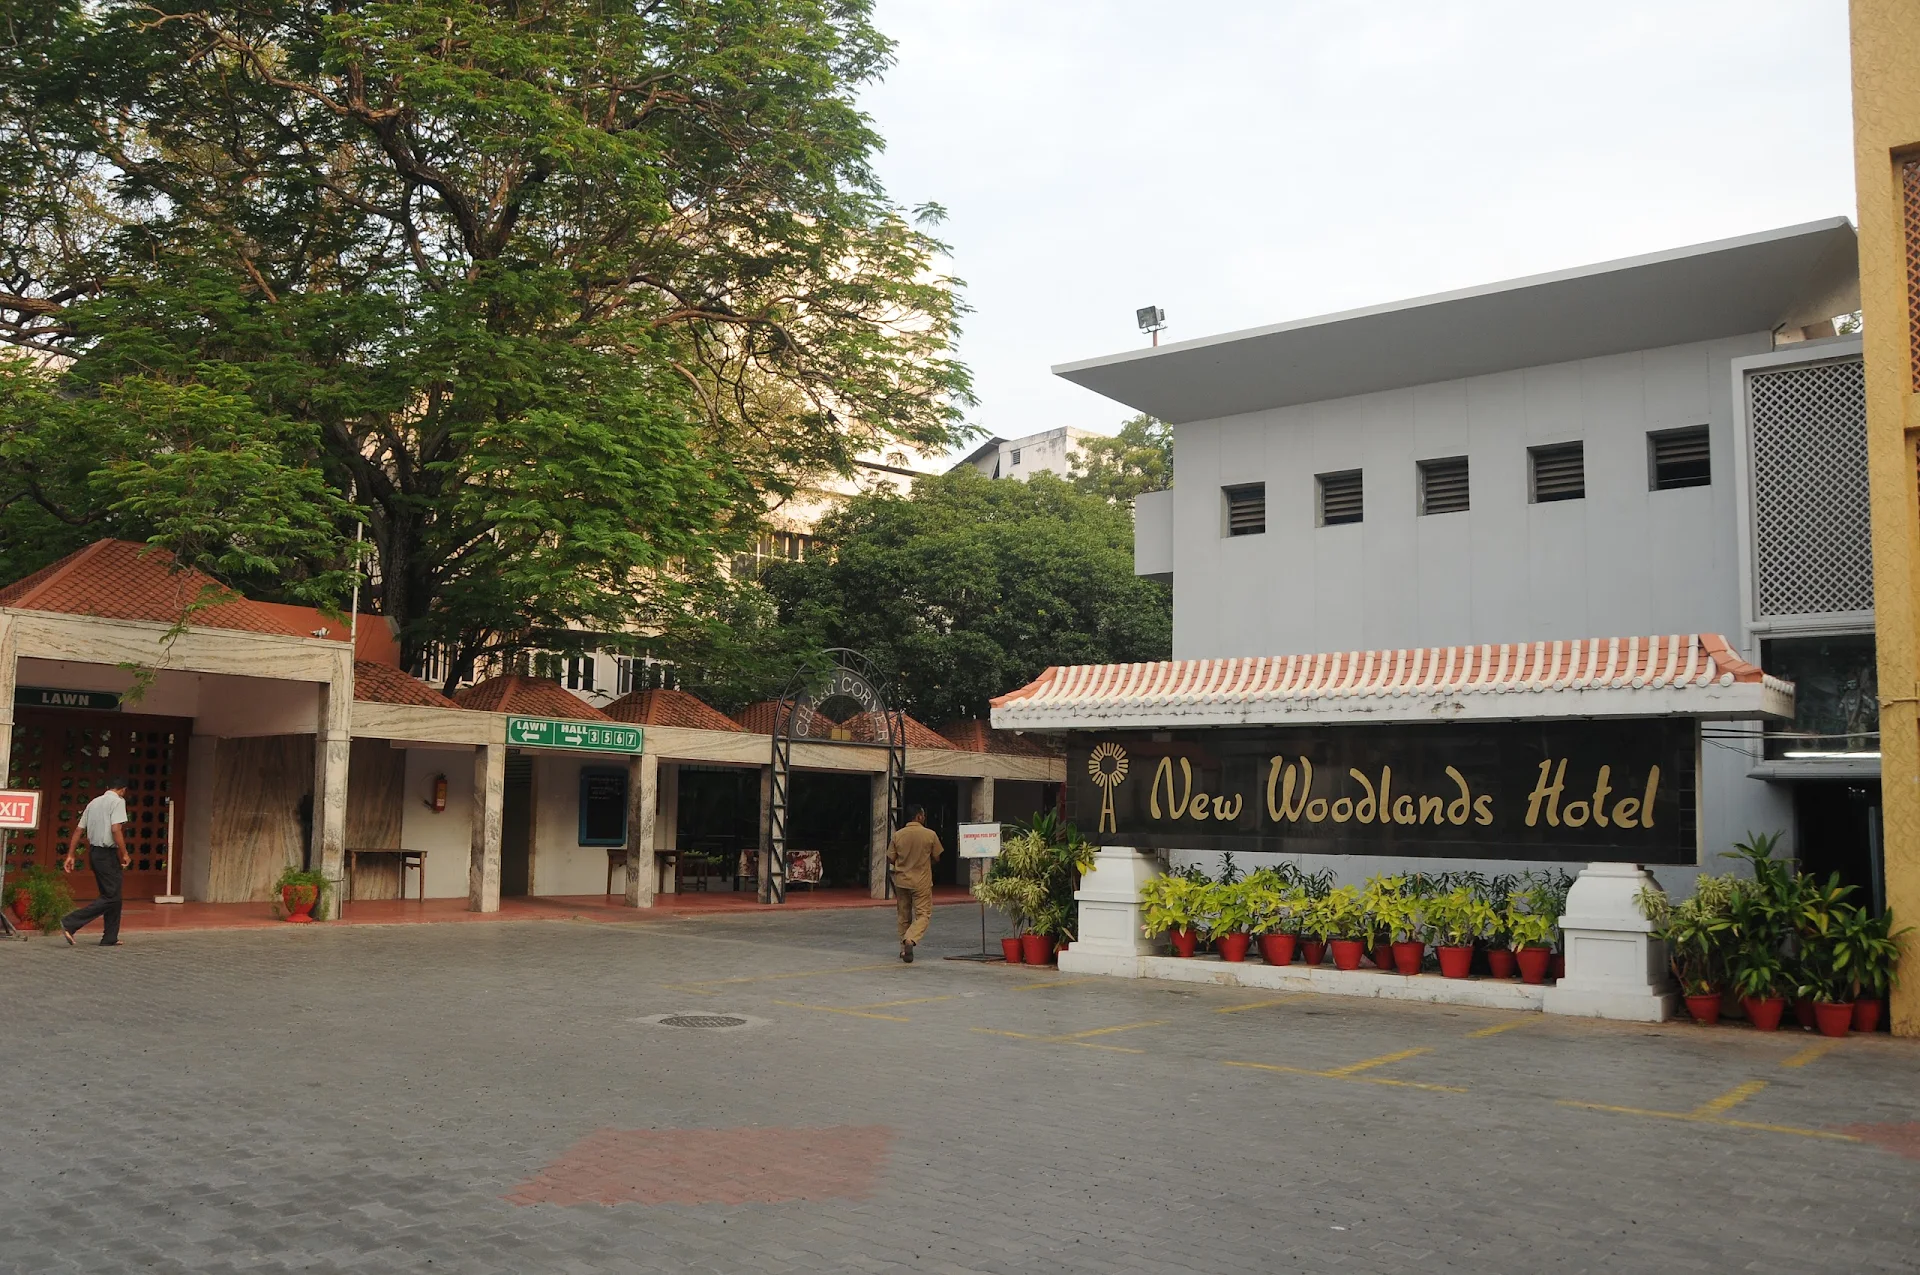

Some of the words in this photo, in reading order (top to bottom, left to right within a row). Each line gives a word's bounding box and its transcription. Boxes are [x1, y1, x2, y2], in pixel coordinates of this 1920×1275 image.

[41, 692, 90, 706] LAWN
[516, 721, 547, 732] LAWN
[561, 724, 588, 735] HALL
[1150, 756, 1243, 821] New
[1267, 755, 1494, 826] Woodlands
[1524, 757, 1660, 829] Hotel
